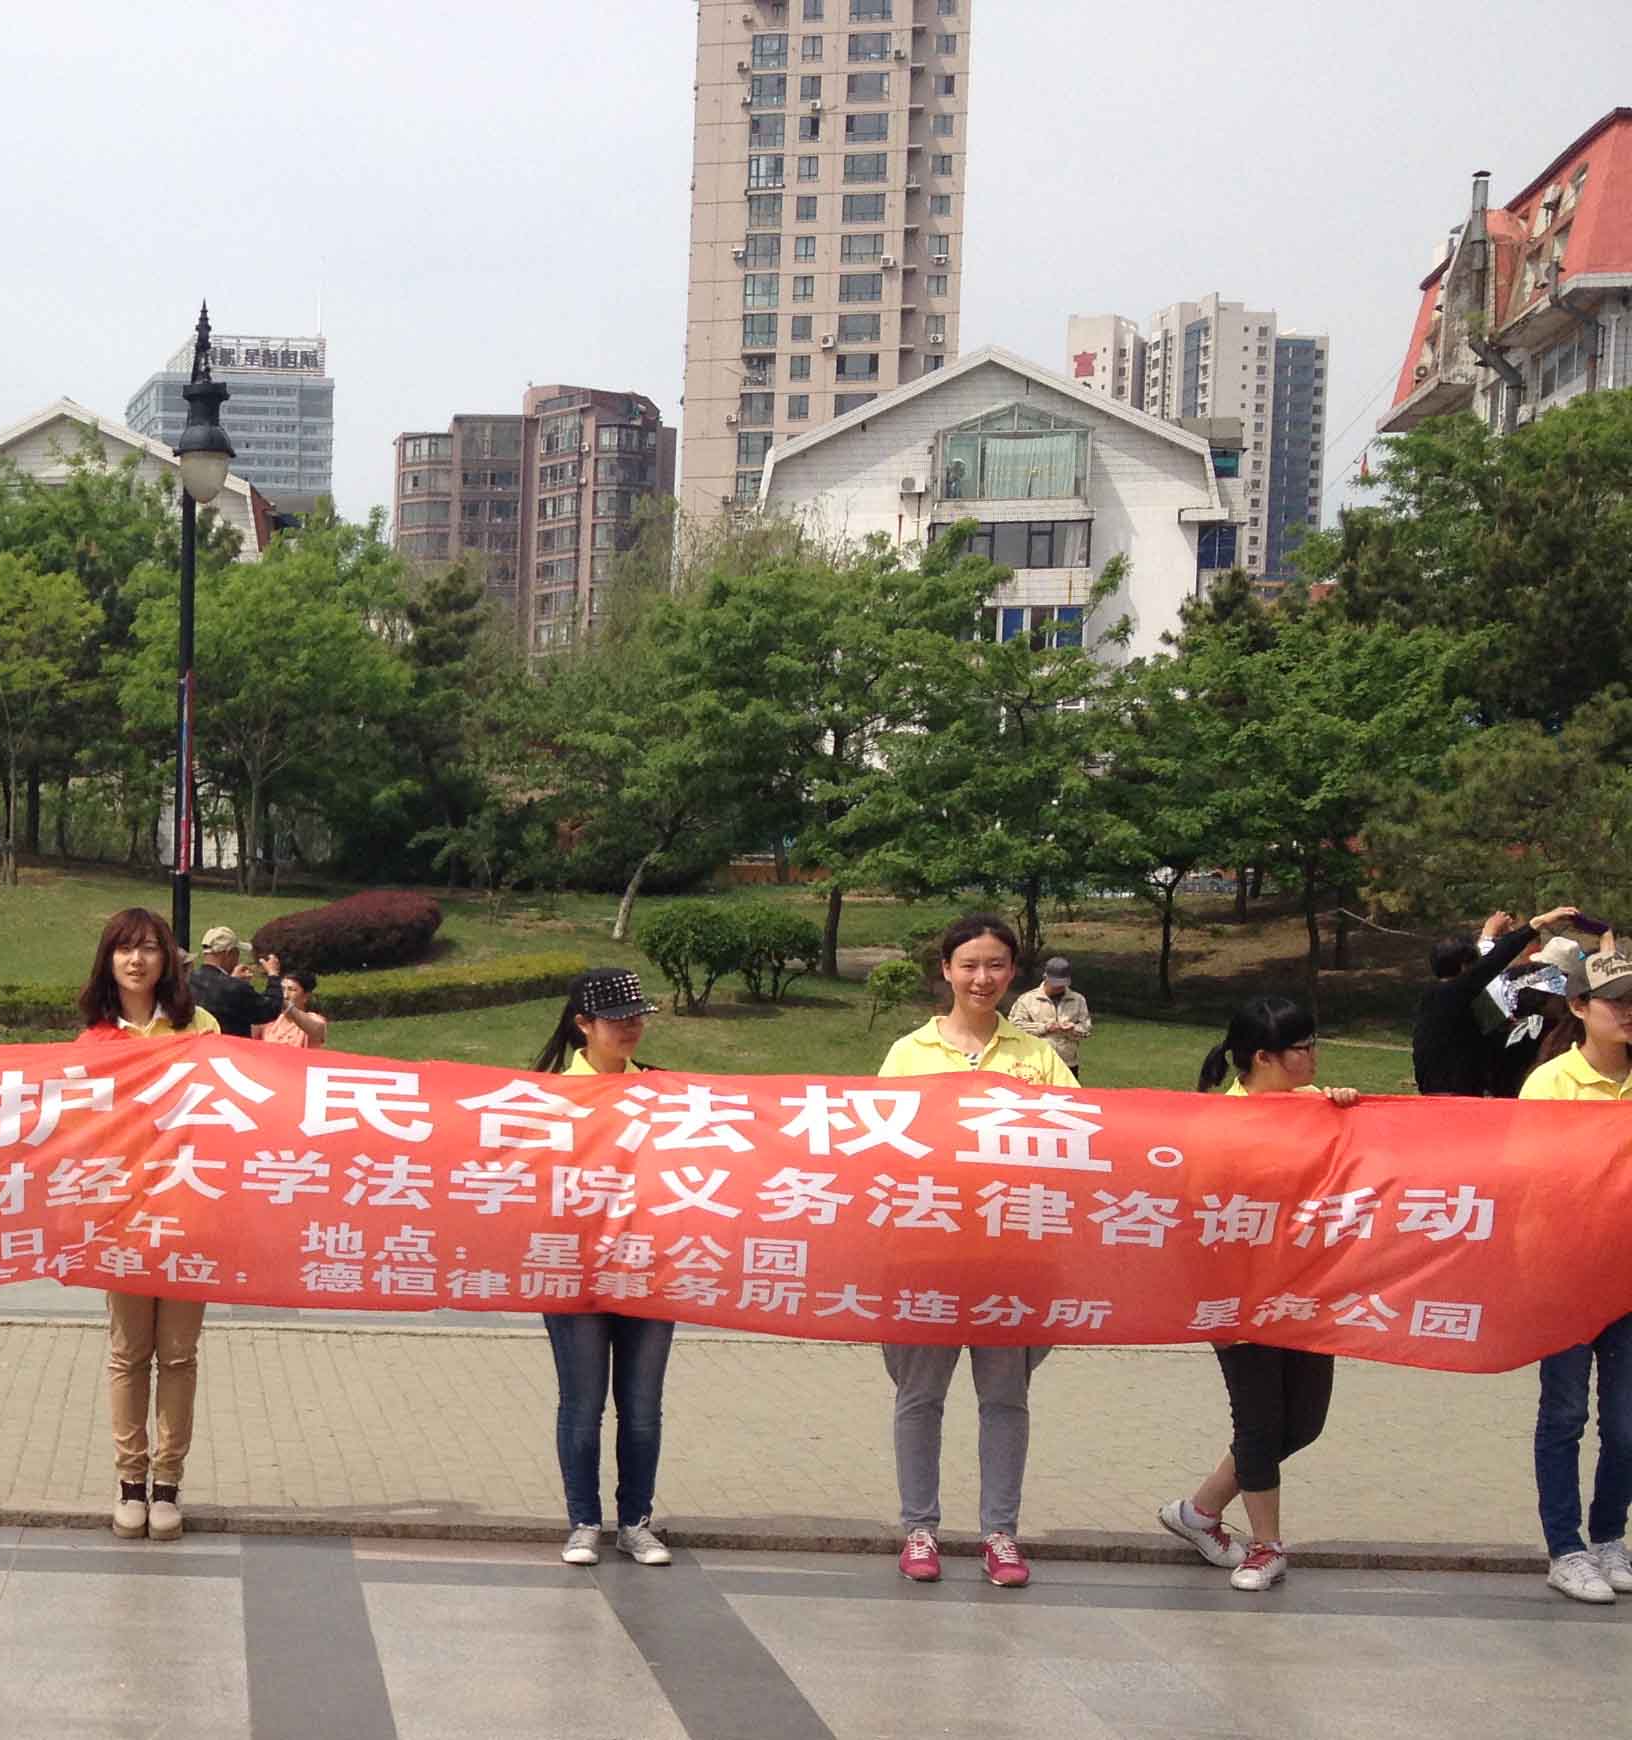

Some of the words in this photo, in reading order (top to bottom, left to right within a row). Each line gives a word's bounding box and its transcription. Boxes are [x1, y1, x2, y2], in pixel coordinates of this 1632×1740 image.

[300, 1221, 808, 1279] 地点：星海公园
[1186, 1292, 1483, 1342] 星海公园
